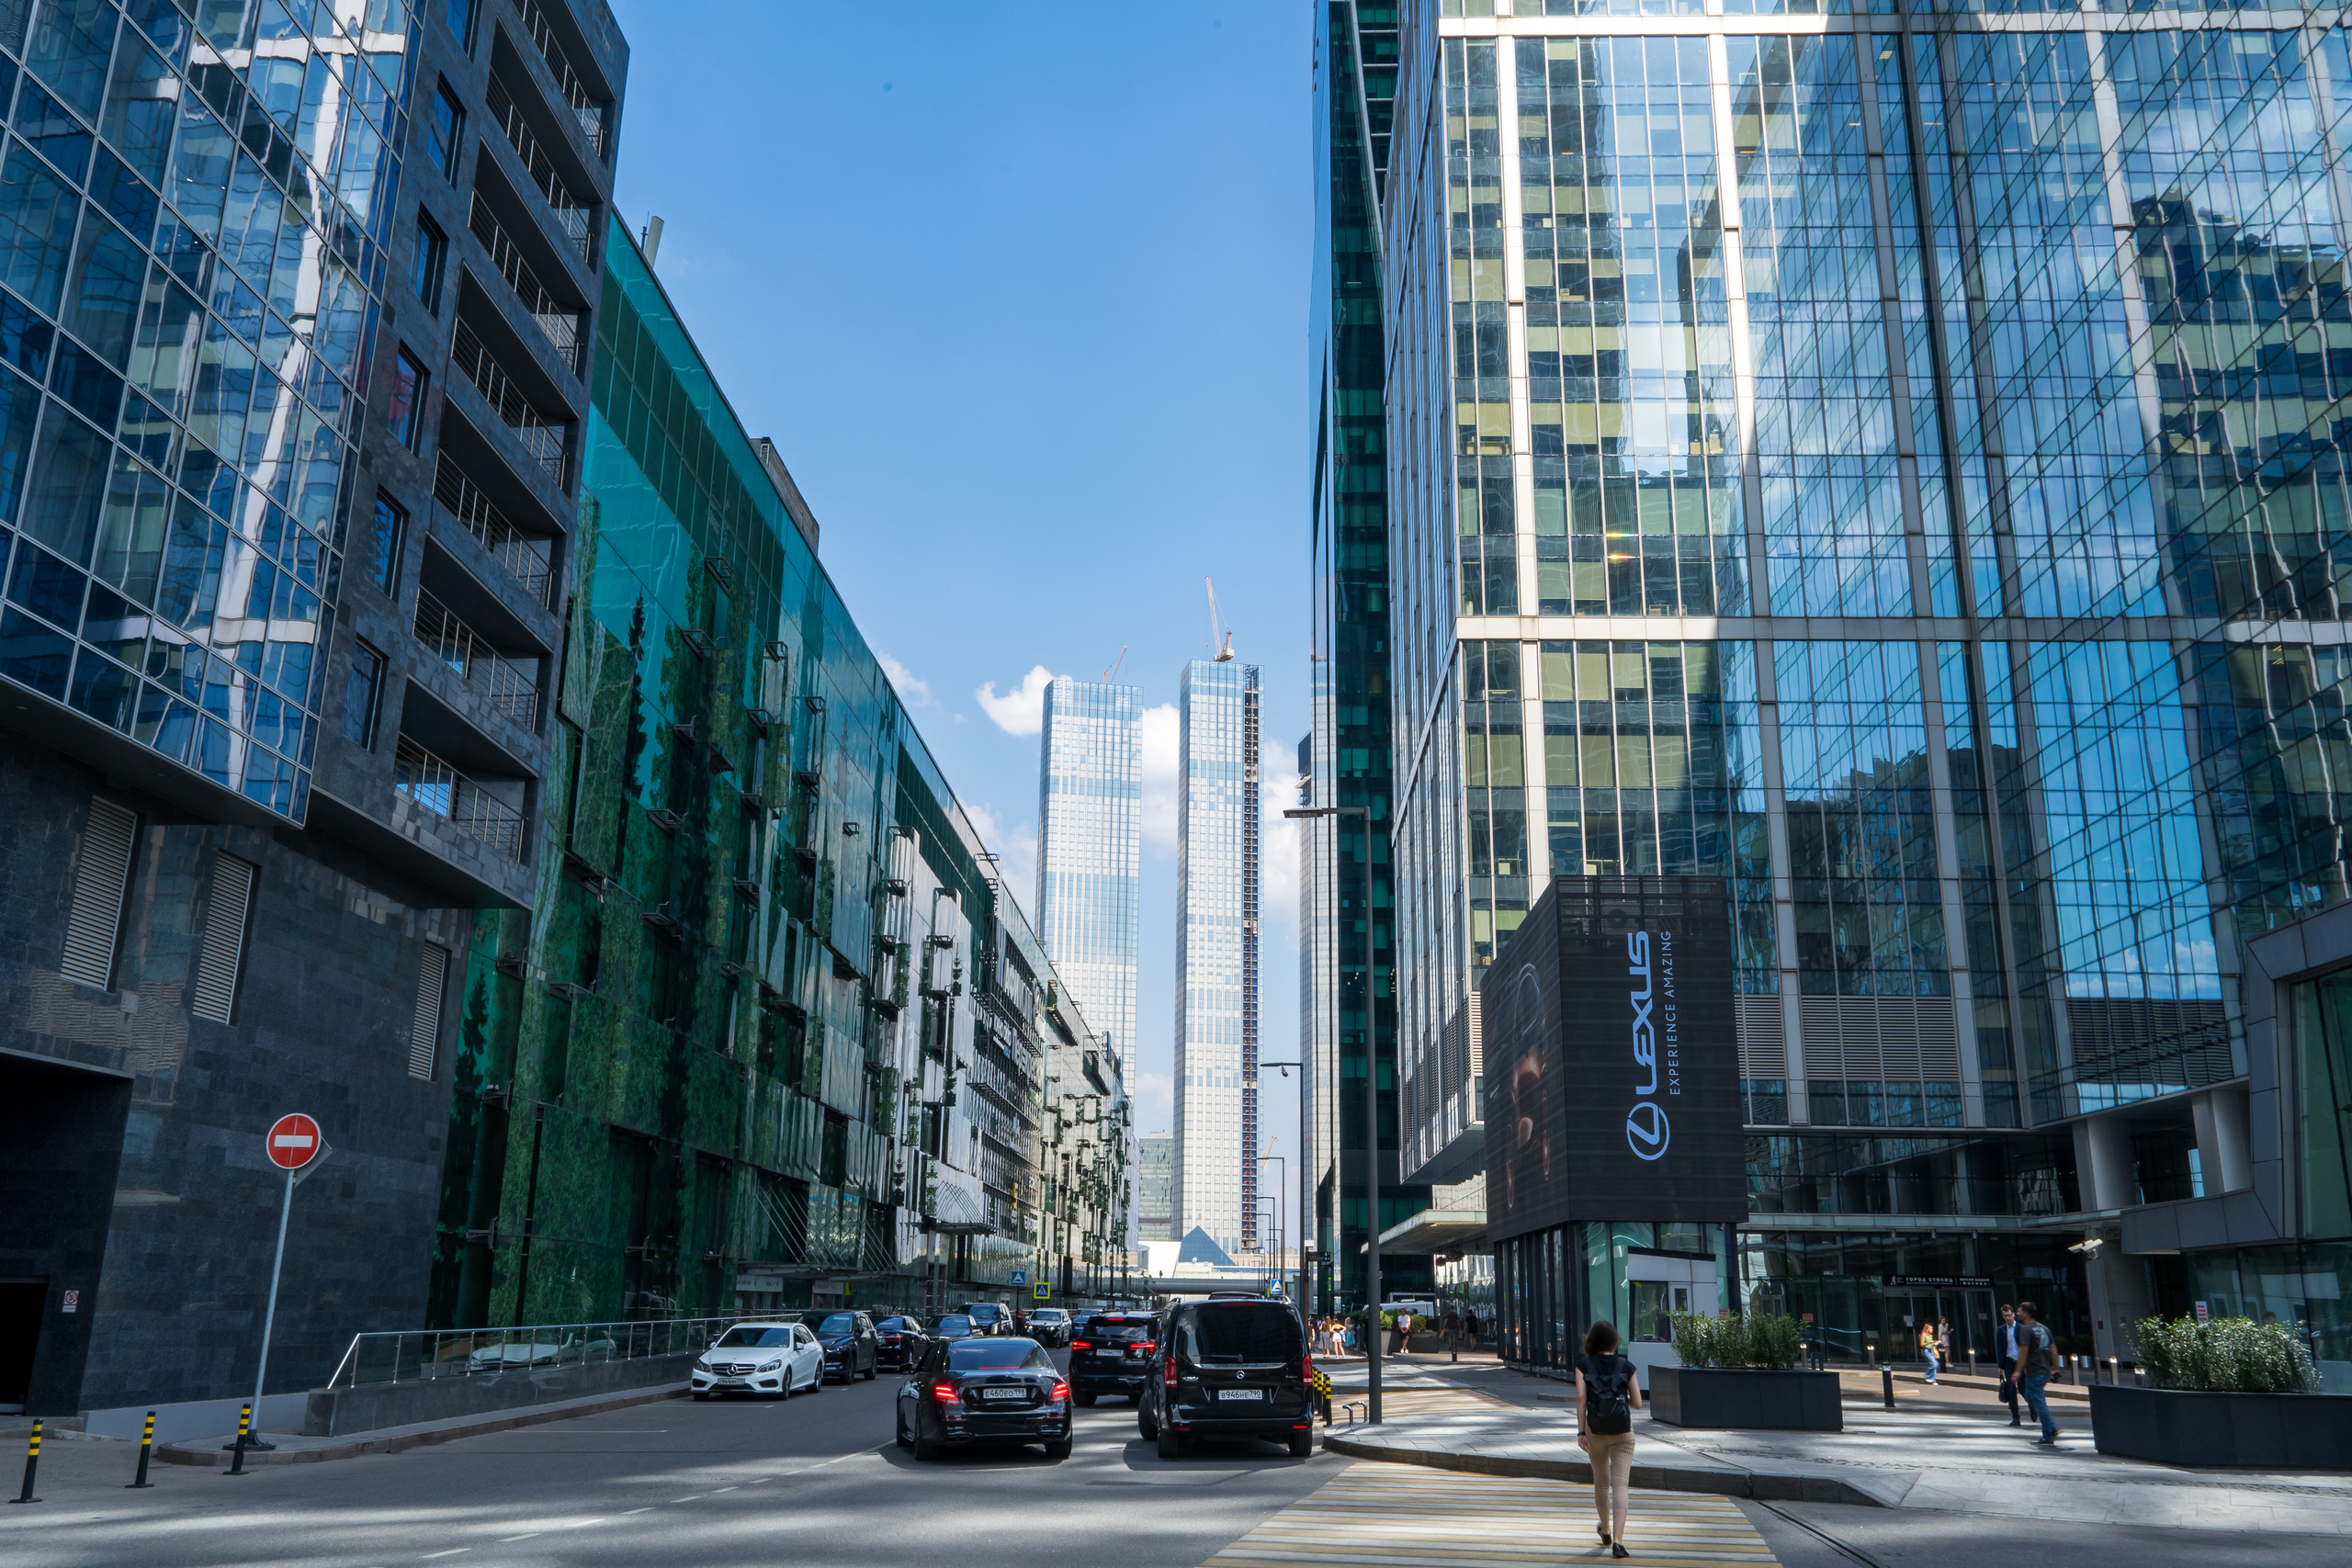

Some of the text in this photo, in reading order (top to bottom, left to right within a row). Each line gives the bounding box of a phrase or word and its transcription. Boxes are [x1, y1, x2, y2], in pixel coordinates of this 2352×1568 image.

[1627, 931, 1657, 1095] LEXUS
[1660, 931, 1680, 1095] EXPERIENCE AMAZING
